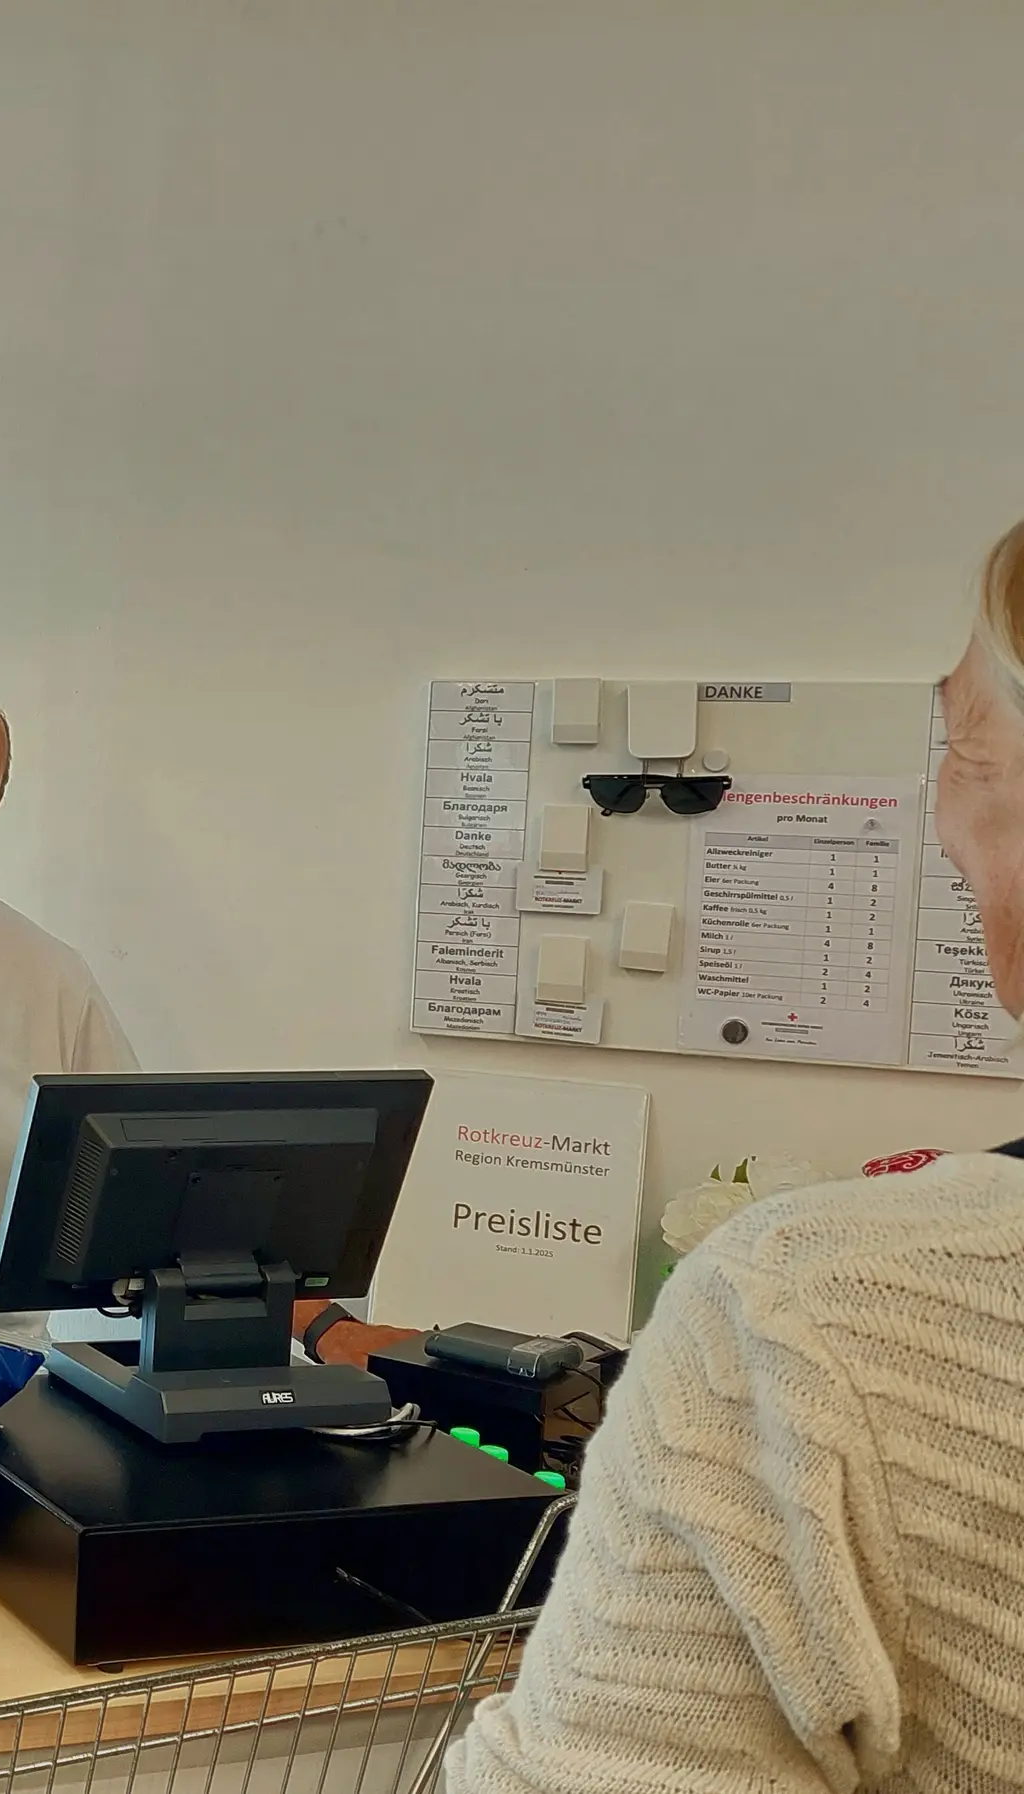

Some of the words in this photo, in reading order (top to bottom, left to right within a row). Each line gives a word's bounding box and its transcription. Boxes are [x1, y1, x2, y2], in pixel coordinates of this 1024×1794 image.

[705, 685, 764, 699] DANKE
[460, 772, 493, 783] Hvala
[443, 800, 508, 814] Благодаря
[776, 815, 794, 825] pro
[796, 814, 828, 824] Monat
[455, 830, 492, 842] Danke
[706, 848, 773, 859] Allzweckreiniger
[830, 854, 836, 862] 1
[873, 856, 879, 864] 1
[706, 862, 731, 870] Butter
[829, 868, 835, 876] 1
[872, 870, 878, 878] 1
[704, 876, 720, 884] Eier
[827, 882, 834, 890] 4
[871, 884, 878, 893] 8
[704, 890, 778, 901] Geschirrspülmittel
[827, 897, 833, 905] 1
[870, 899, 877, 907] 2
[703, 904, 729, 912] Kaffee
[826, 911, 832, 919] 1
[869, 913, 876, 921] 2
[702, 918, 750, 928] Küchenrolle
[825, 925, 831, 933] 1
[868, 928, 874, 936] 1
[701, 932, 723, 940] Milch
[824, 940, 831, 948] 4
[867, 942, 874, 950] 8
[431, 945, 505, 959] Faleminderit
[700, 946, 721, 955] Sirup
[823, 954, 829, 962] 1
[866, 957, 873, 965] 2
[935, 943, 987, 957] Teşekk
[699, 960, 732, 969] Speiseöl
[822, 968, 829, 976] 2
[865, 971, 872, 979] 4
[449, 975, 482, 986] Hvala
[699, 974, 749, 984] Waschmittel
[864, 985, 871, 993] 2
[697, 988, 740, 998] WC-Papier
[820, 997, 827, 1005] 2
[863, 999, 870, 1007] 4
[428, 1002, 502, 1017] Благодарам
[953, 1008, 989, 1020] Kösz
[457, 1125, 611, 1156] Rotkreuz-Markt
[455, 1149, 502, 1167] Region
[506, 1155, 611, 1177] Kremsmünster
[452, 1203, 603, 1245] Preisliste
[495, 1244, 520, 1255] Stand:
[521, 1247, 554, 1258] 1.1.2025
[262, 1391, 294, 1404] AURES
